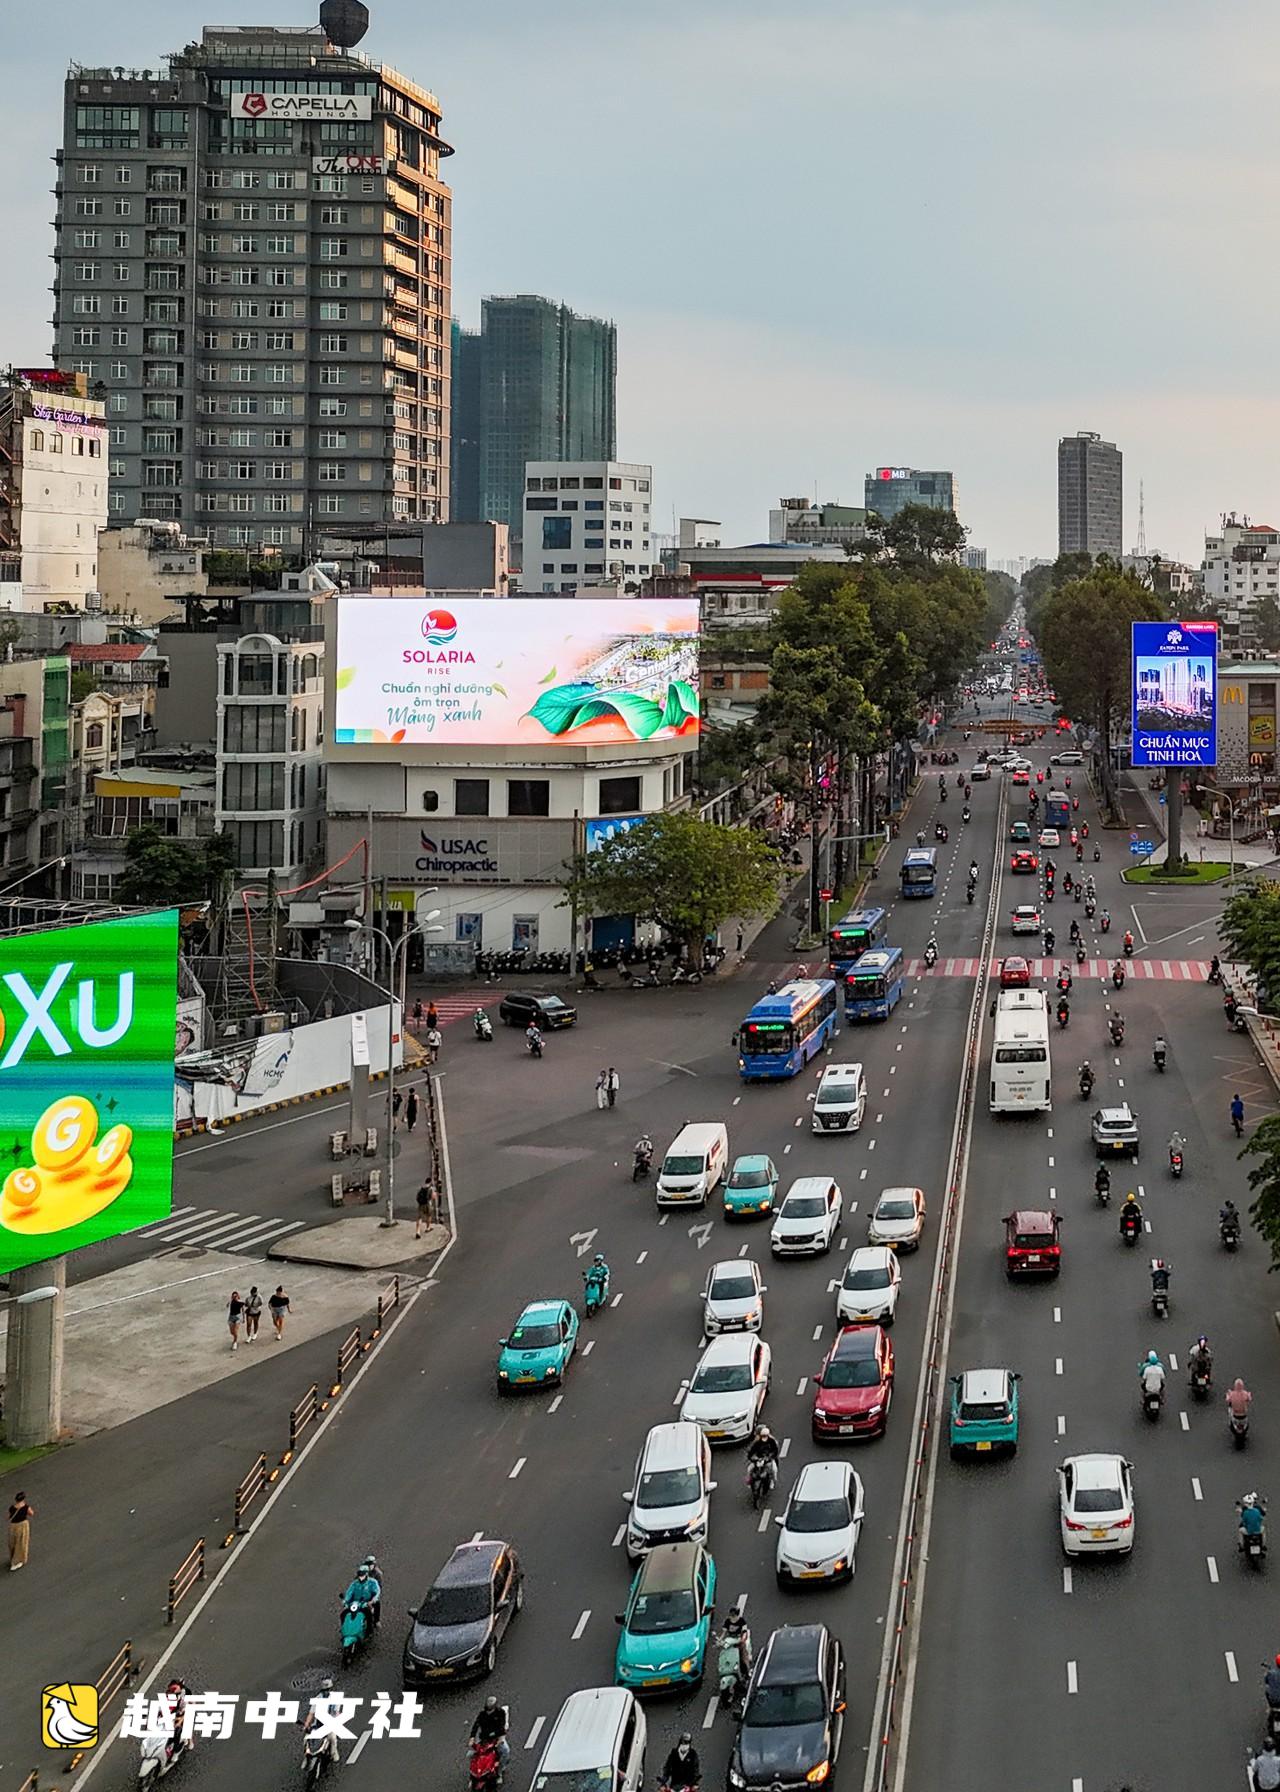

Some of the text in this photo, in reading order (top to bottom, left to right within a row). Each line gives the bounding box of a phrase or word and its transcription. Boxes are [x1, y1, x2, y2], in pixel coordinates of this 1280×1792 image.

[271, 98, 357, 111] CAPELLA
[317, 148, 382, 173] The ONE
[891, 470, 906, 479] MB
[402, 650, 476, 664] SOLARIA
[427, 667, 451, 675] RISE
[381, 682, 421, 693] Chuẩn
[413, 696, 460, 709] ôm trọn
[443, 699, 483, 723] xanh
[1139, 734, 1209, 751] CHUẨN MỰC
[1146, 751, 1201, 762] TINH HOA
[441, 840, 487, 854] USAC
[415, 857, 497, 874] Chiropractic
[0, 961, 134, 1070] Xu
